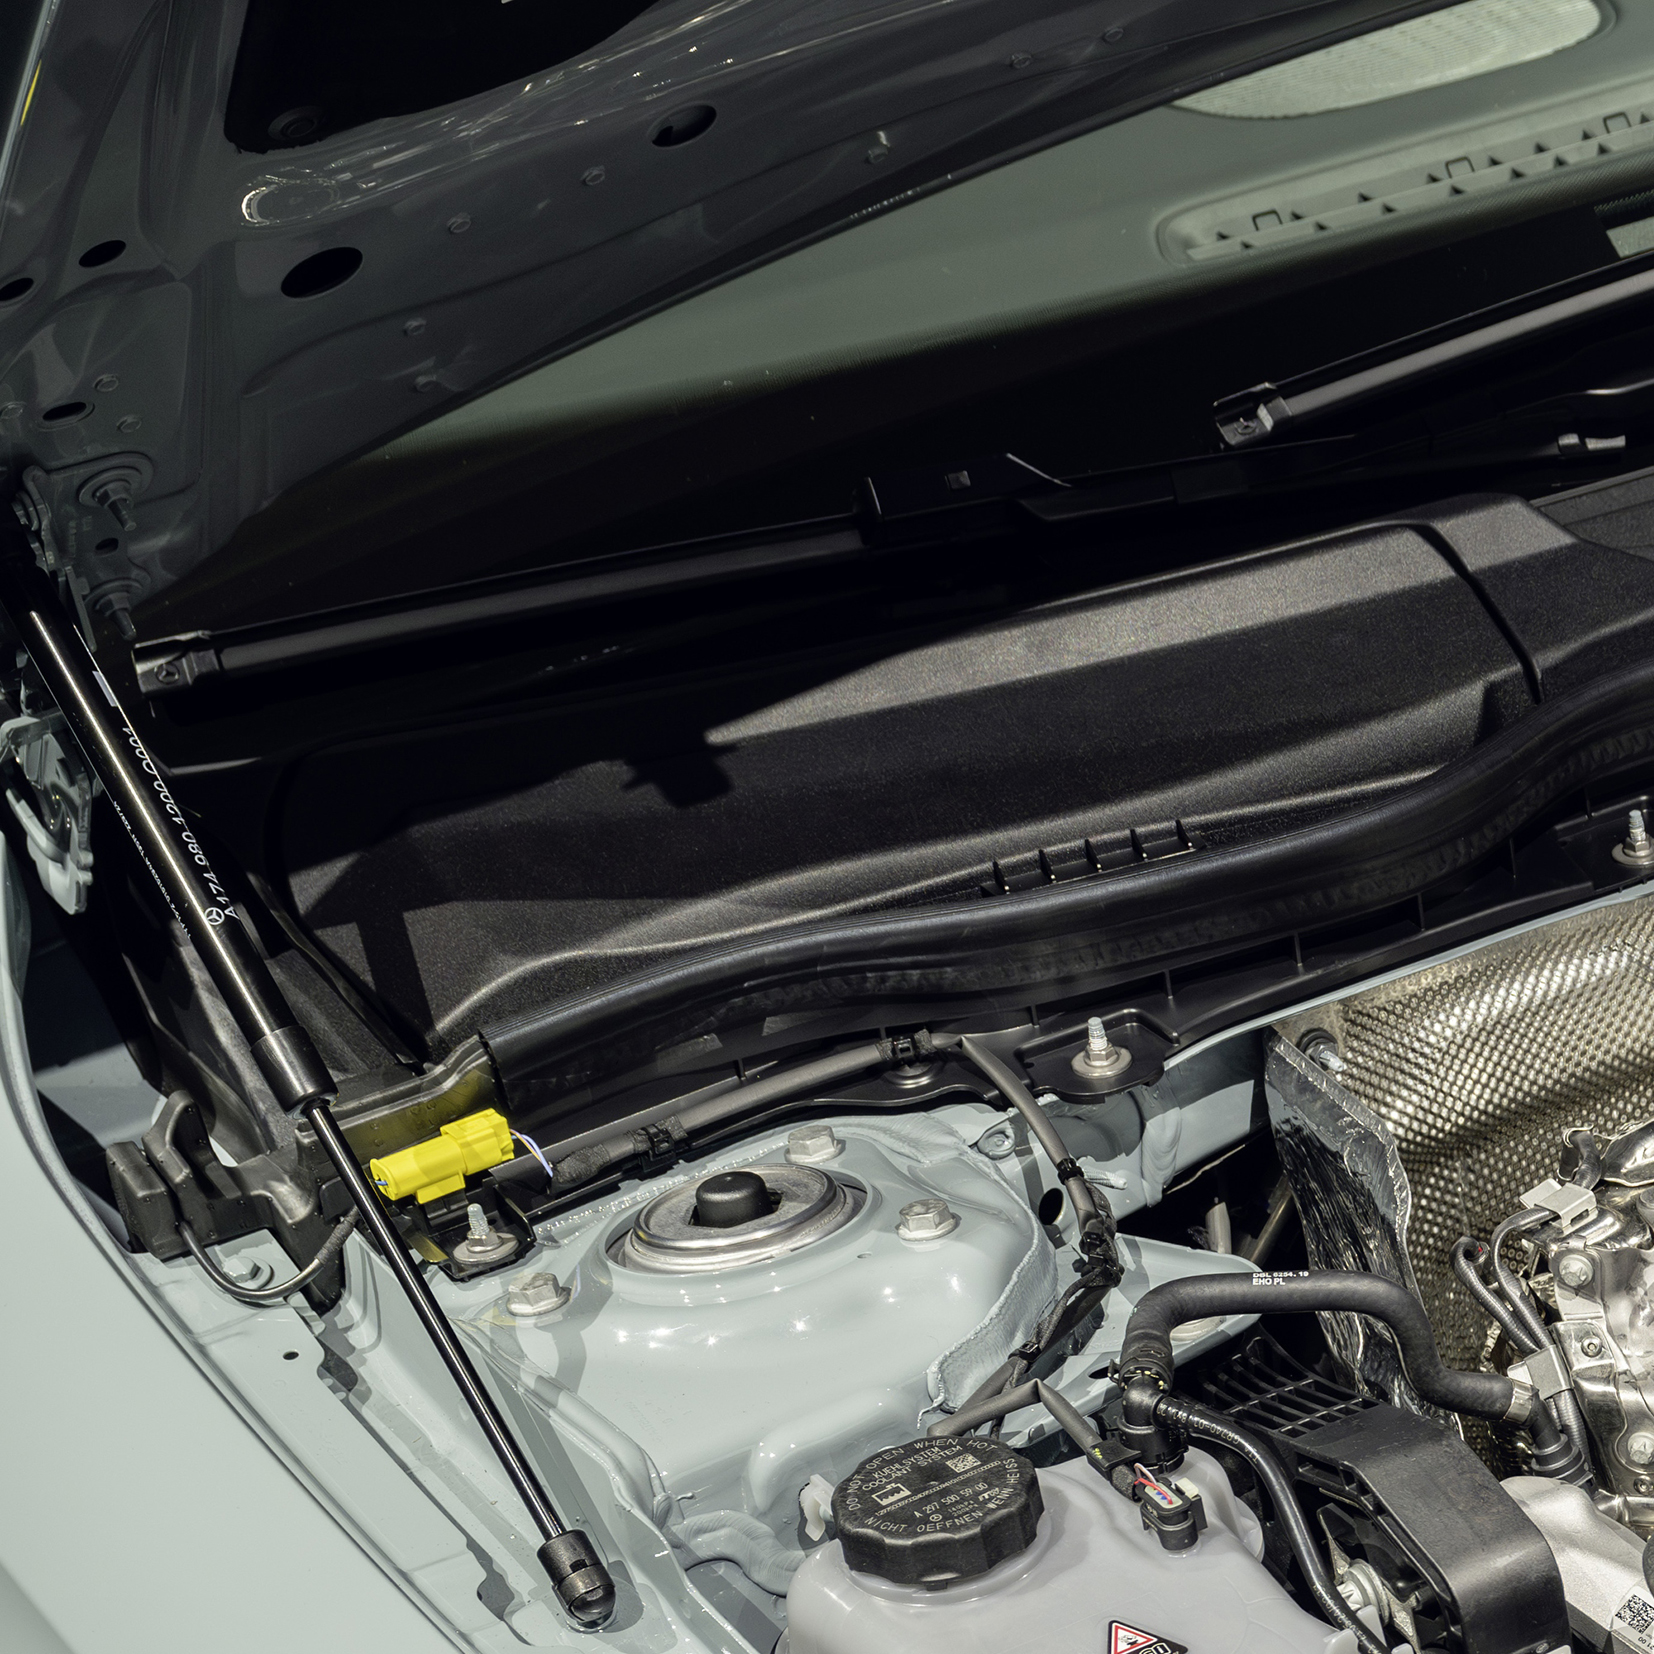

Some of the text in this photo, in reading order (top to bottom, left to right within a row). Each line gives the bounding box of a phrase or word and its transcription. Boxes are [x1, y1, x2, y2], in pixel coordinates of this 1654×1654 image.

[153, 780, 186, 825] 1200
[181, 831, 210, 867] 980
[847, 1474, 865, 1494] NOT
[865, 1448, 905, 1471] OPEN
[913, 1438, 959, 1450] WHEN
[966, 1439, 998, 1453] HOT
[862, 1466, 912, 1491] COOLANT
[918, 1446, 963, 1467] SYSTEM
[872, 1446, 943, 1479] KUEHLSYSTEM
[865, 1517, 908, 1533] NICHT
[916, 1510, 983, 1533] OEFFNEN
[985, 1486, 1015, 1511] WENN
[1002, 1458, 1020, 1485] HEISS
[913, 1482, 989, 1519] A 297 500 59 00
[1637, 1636, 1647, 1645] 00
[1646, 1642, 1654, 1651] 21
